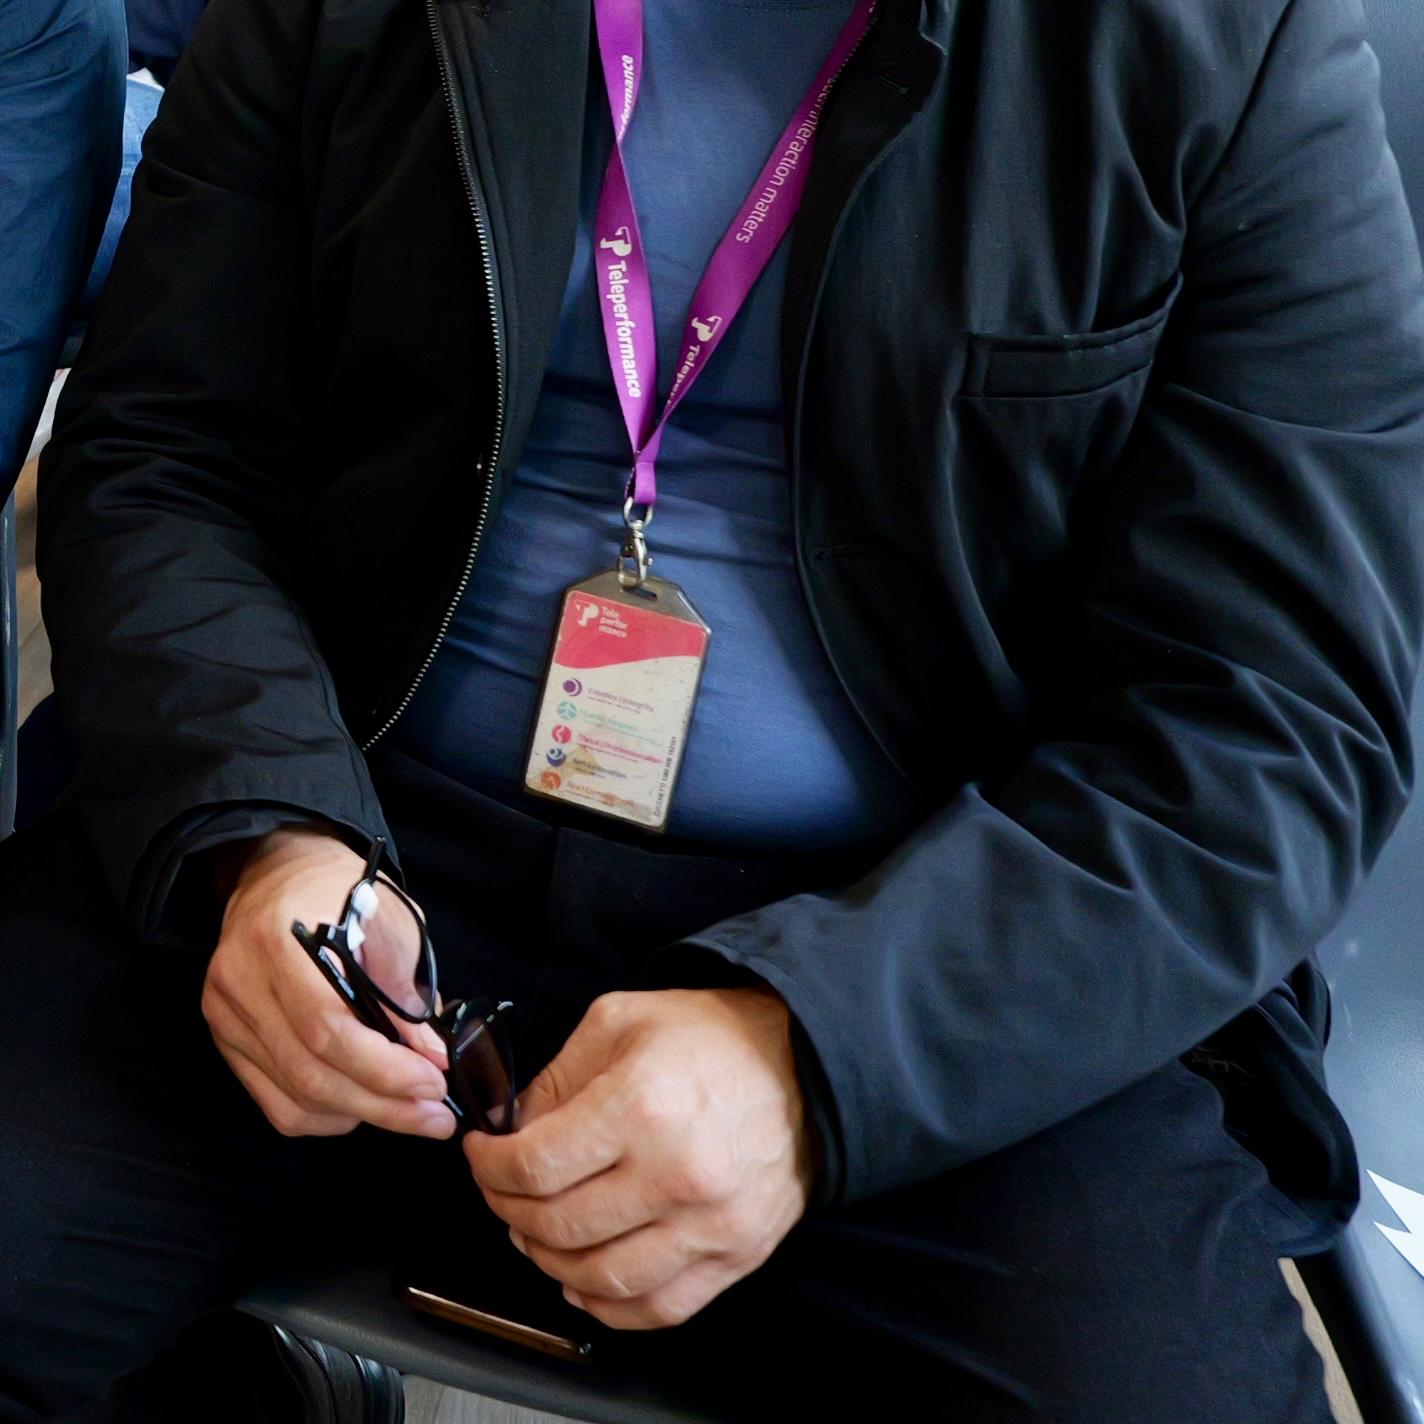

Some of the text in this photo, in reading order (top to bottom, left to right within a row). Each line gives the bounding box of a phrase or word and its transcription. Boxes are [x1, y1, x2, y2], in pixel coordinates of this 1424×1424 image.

[769, 110, 820, 188] interaction
[735, 186, 779, 244] matters
[606, 260, 642, 399] Teleperformance
